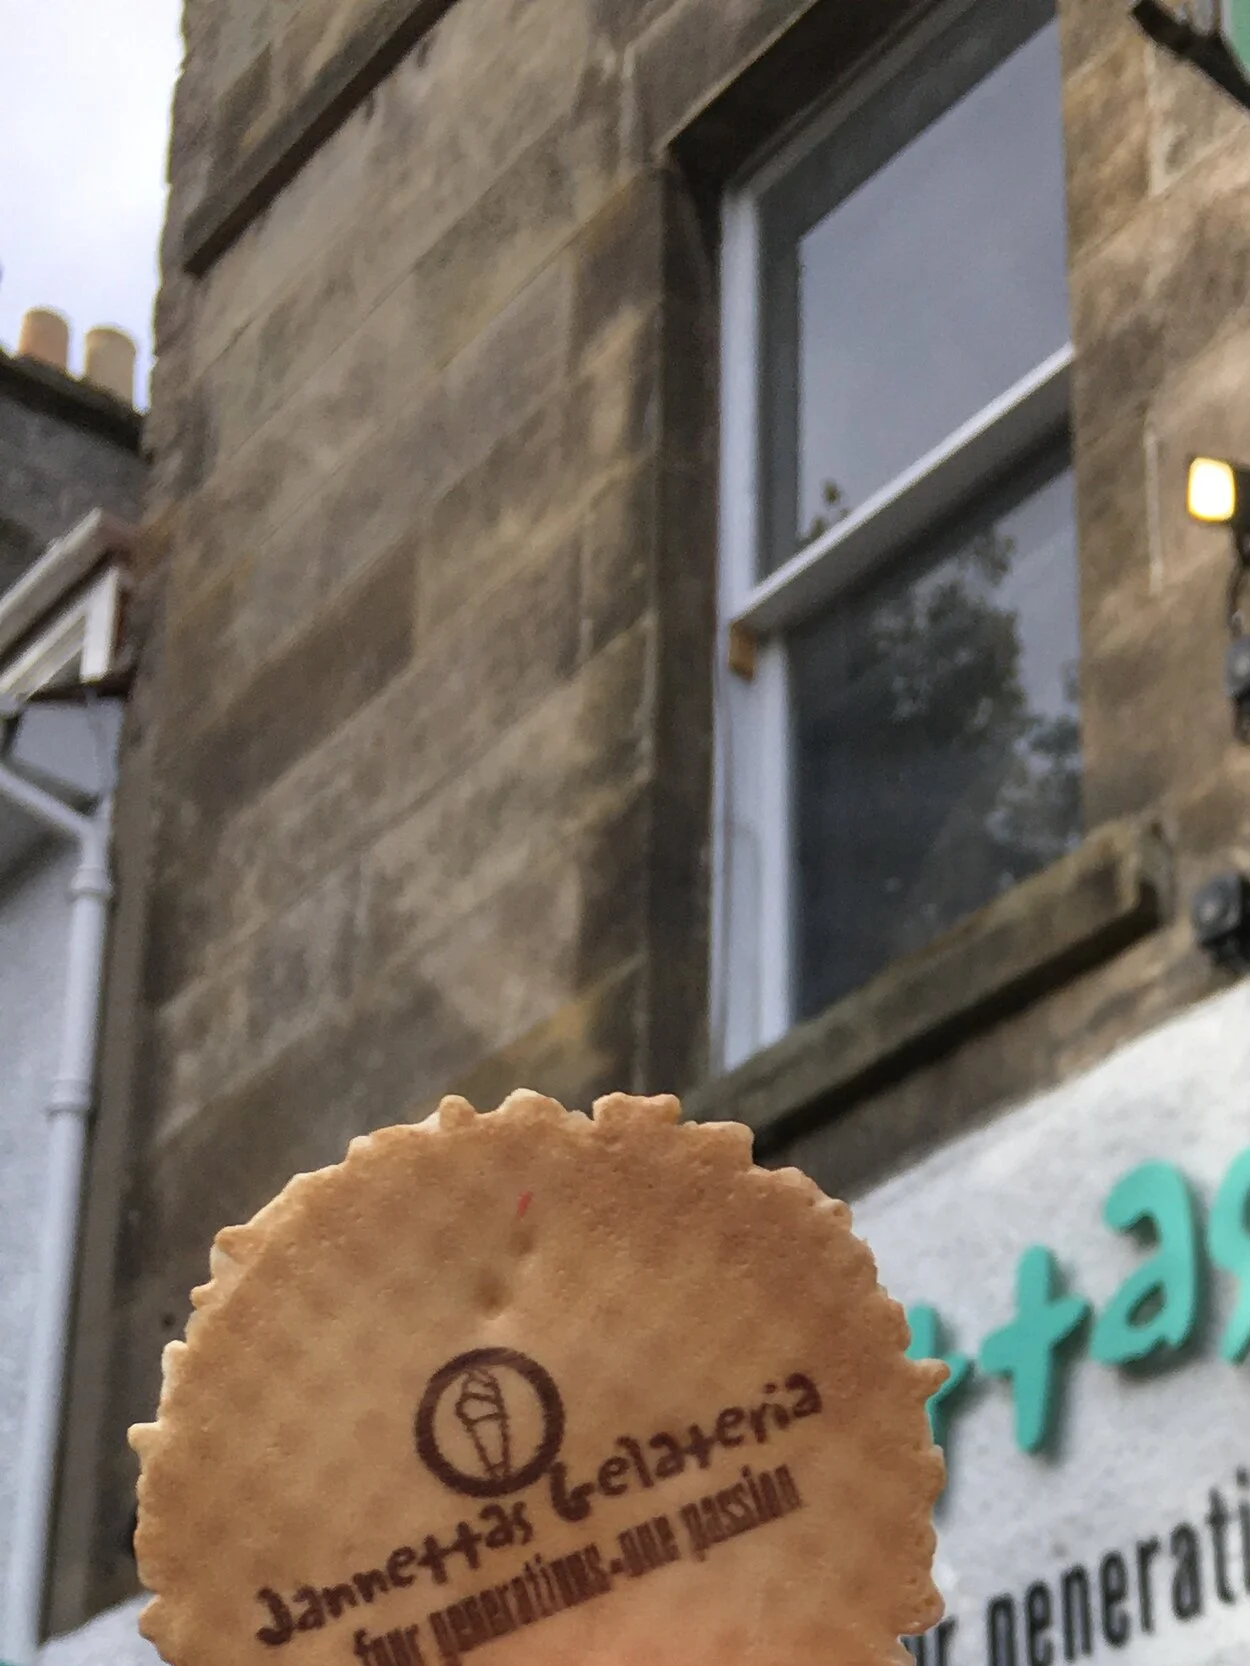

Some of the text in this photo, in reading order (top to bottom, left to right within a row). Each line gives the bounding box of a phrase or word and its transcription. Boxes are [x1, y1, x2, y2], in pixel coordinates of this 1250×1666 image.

[256, 1372, 823, 1647] Jannettas Gelateria
[680, 1464, 803, 1562] passion
